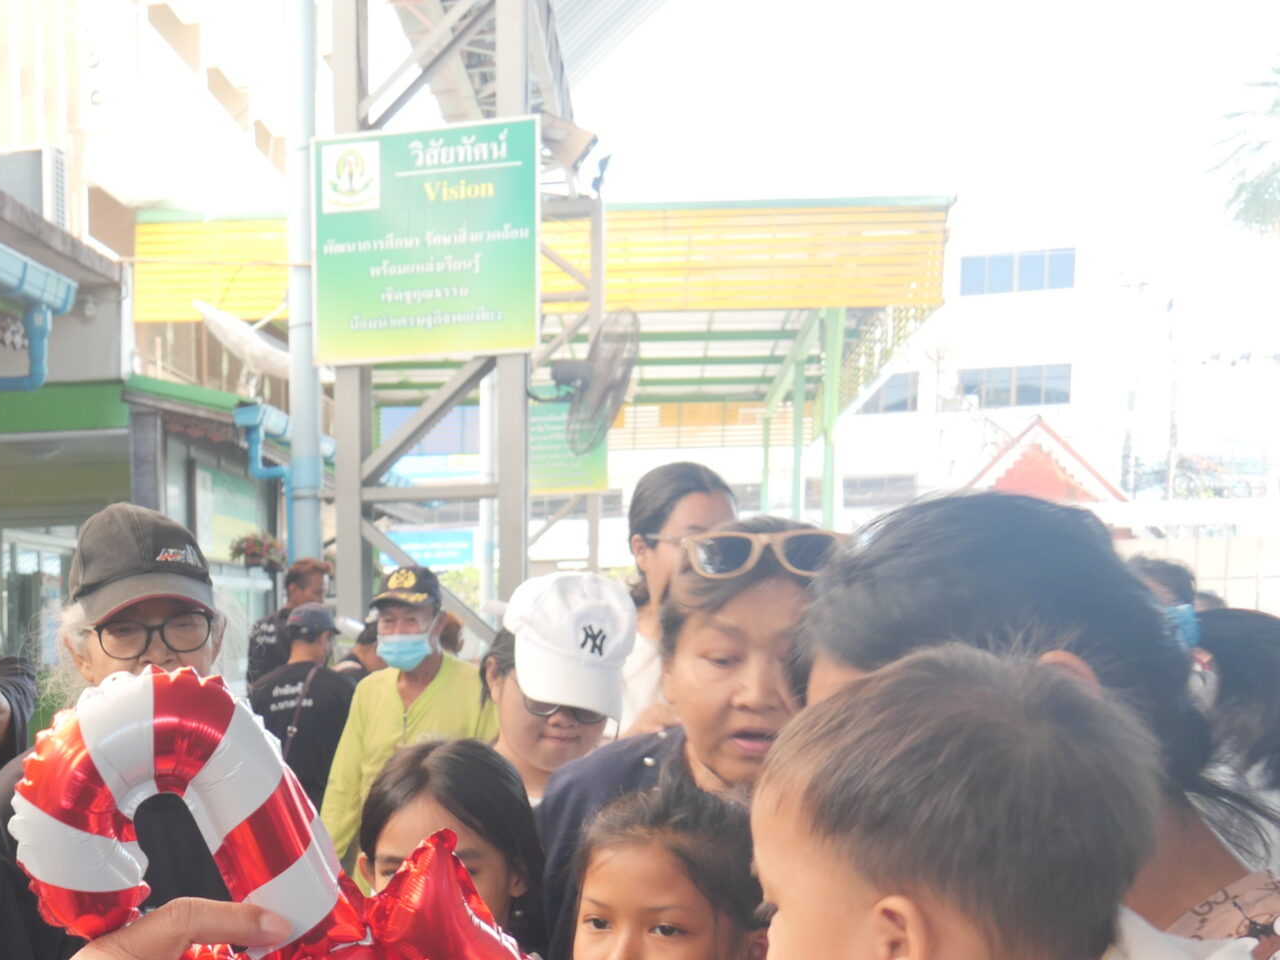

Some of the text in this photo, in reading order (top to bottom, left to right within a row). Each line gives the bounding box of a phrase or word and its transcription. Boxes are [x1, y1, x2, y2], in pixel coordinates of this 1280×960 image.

[408, 128, 509, 167] วิสัยทัศน์
[423, 179, 494, 203] Vision
